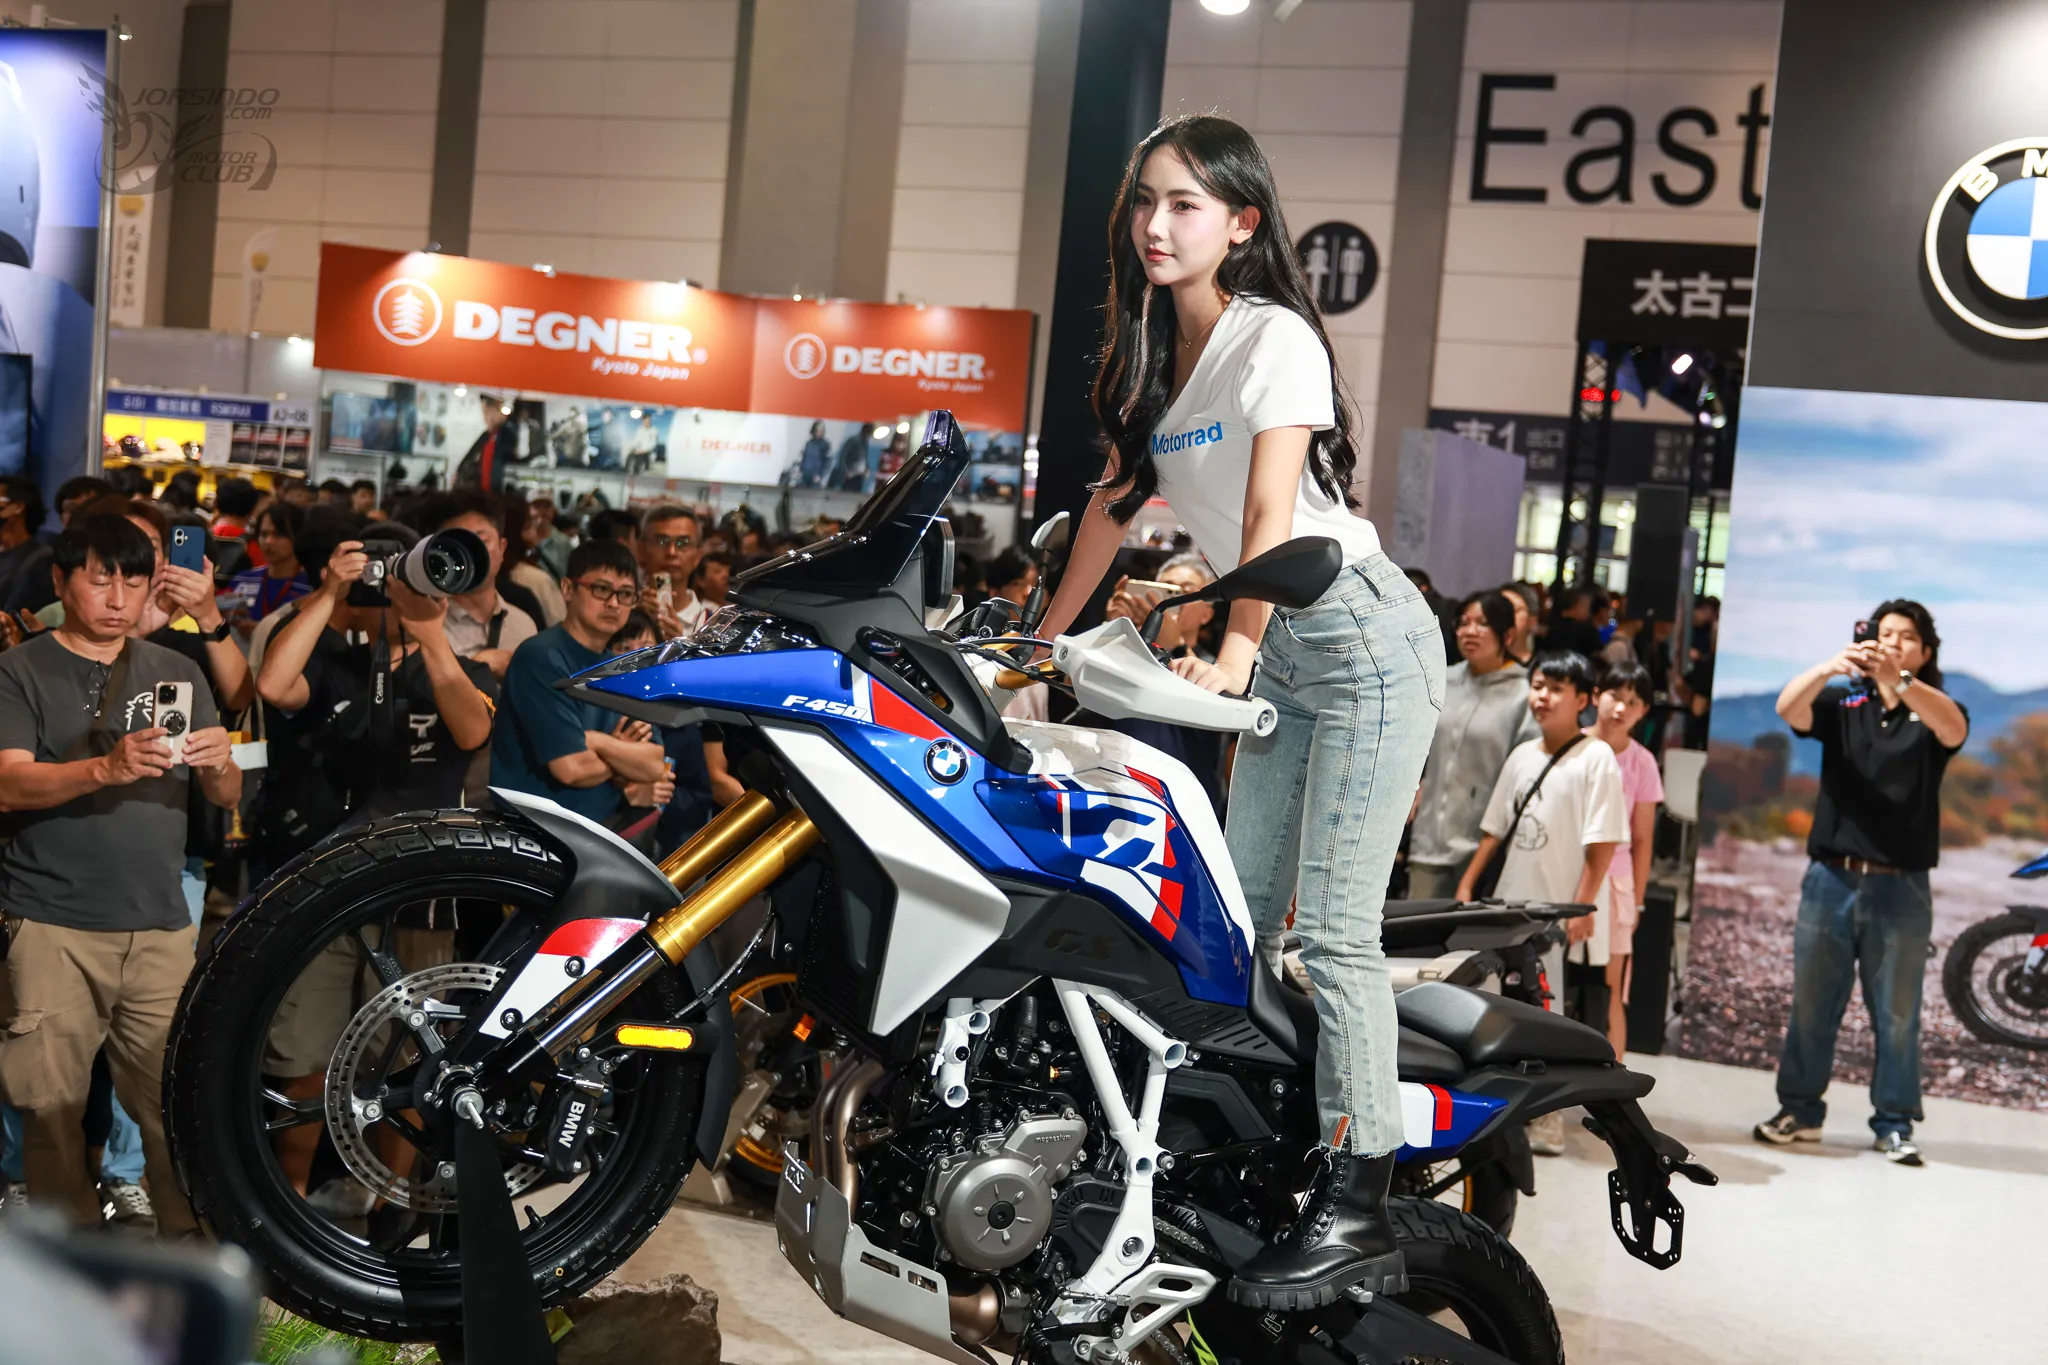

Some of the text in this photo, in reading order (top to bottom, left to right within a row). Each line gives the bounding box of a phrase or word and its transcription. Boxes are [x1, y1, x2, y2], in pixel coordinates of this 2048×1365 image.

[1470, 74, 1769, 211] East
[453, 300, 693, 364] DEGNER
[592, 357, 690, 381] Kyoto Japan
[832, 345, 986, 380] DEGNER
[1152, 421, 1223, 455] Motorrad
[375, 672, 384, 704] Canon
[558, 1101, 586, 1149] BMW
